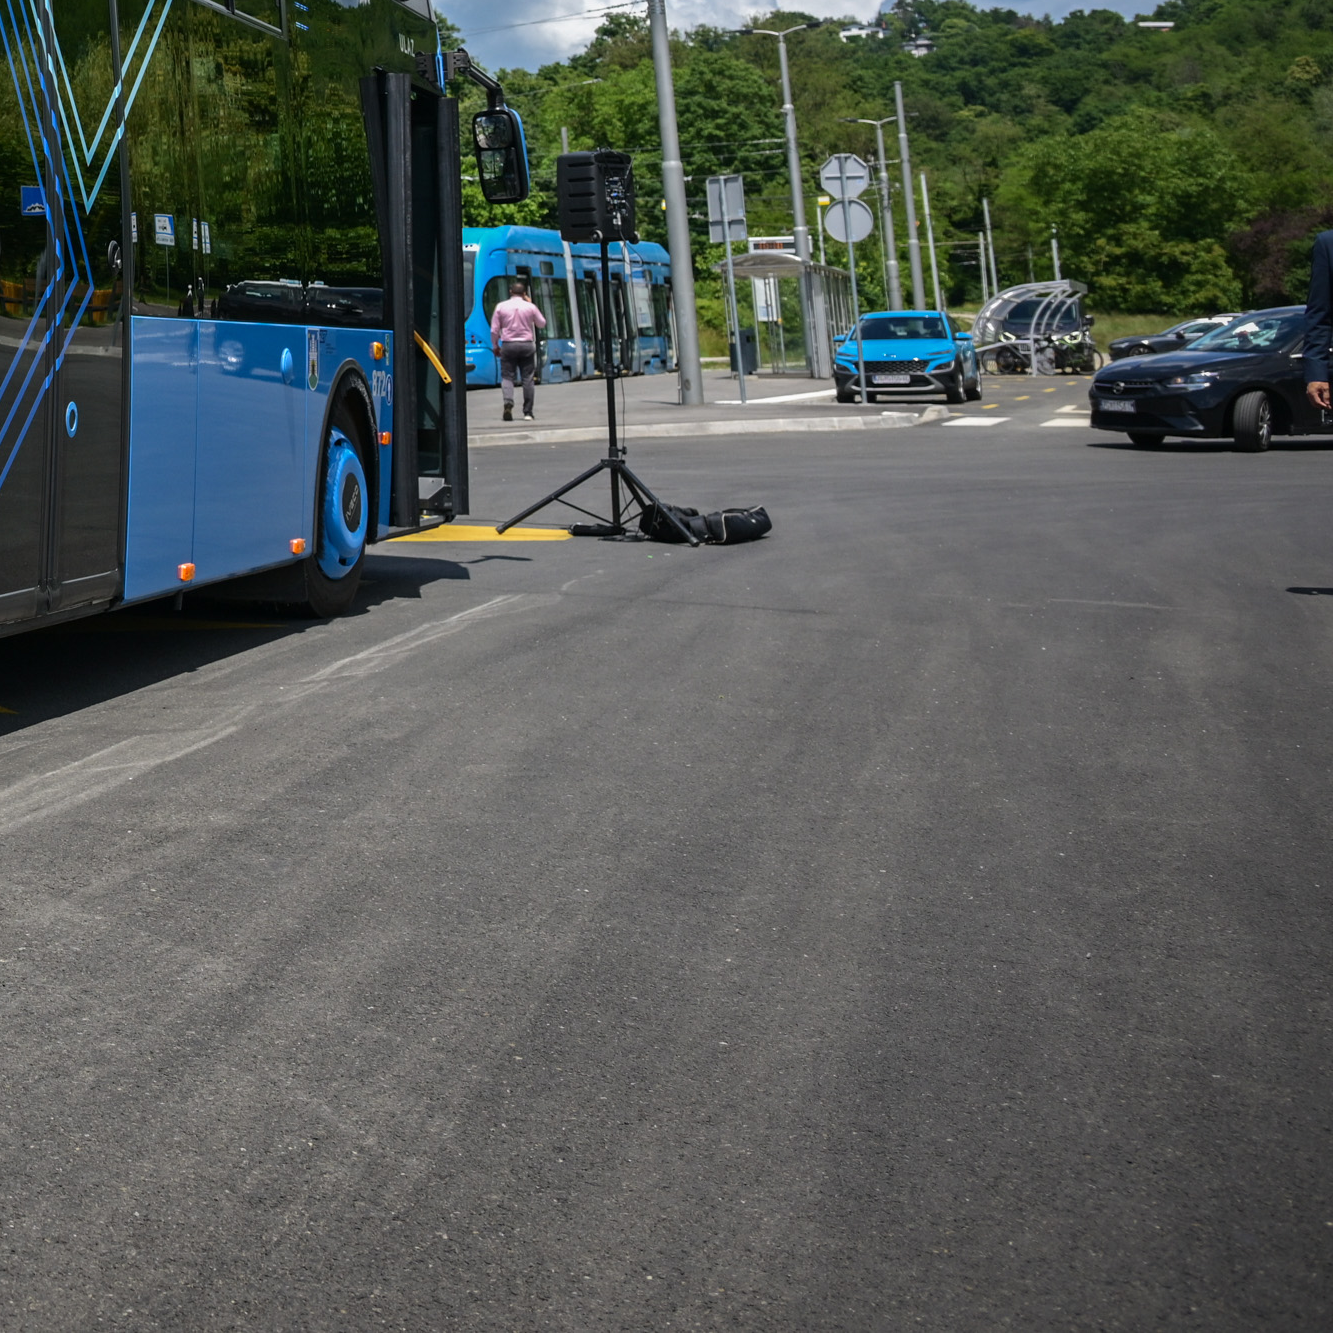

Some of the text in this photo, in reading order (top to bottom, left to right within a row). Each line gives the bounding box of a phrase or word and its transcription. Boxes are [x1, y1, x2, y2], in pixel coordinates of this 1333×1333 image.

[398, 32, 416, 58] ULAZ
[372, 369, 387, 397] 872
[345, 484, 359, 521] IVECO
